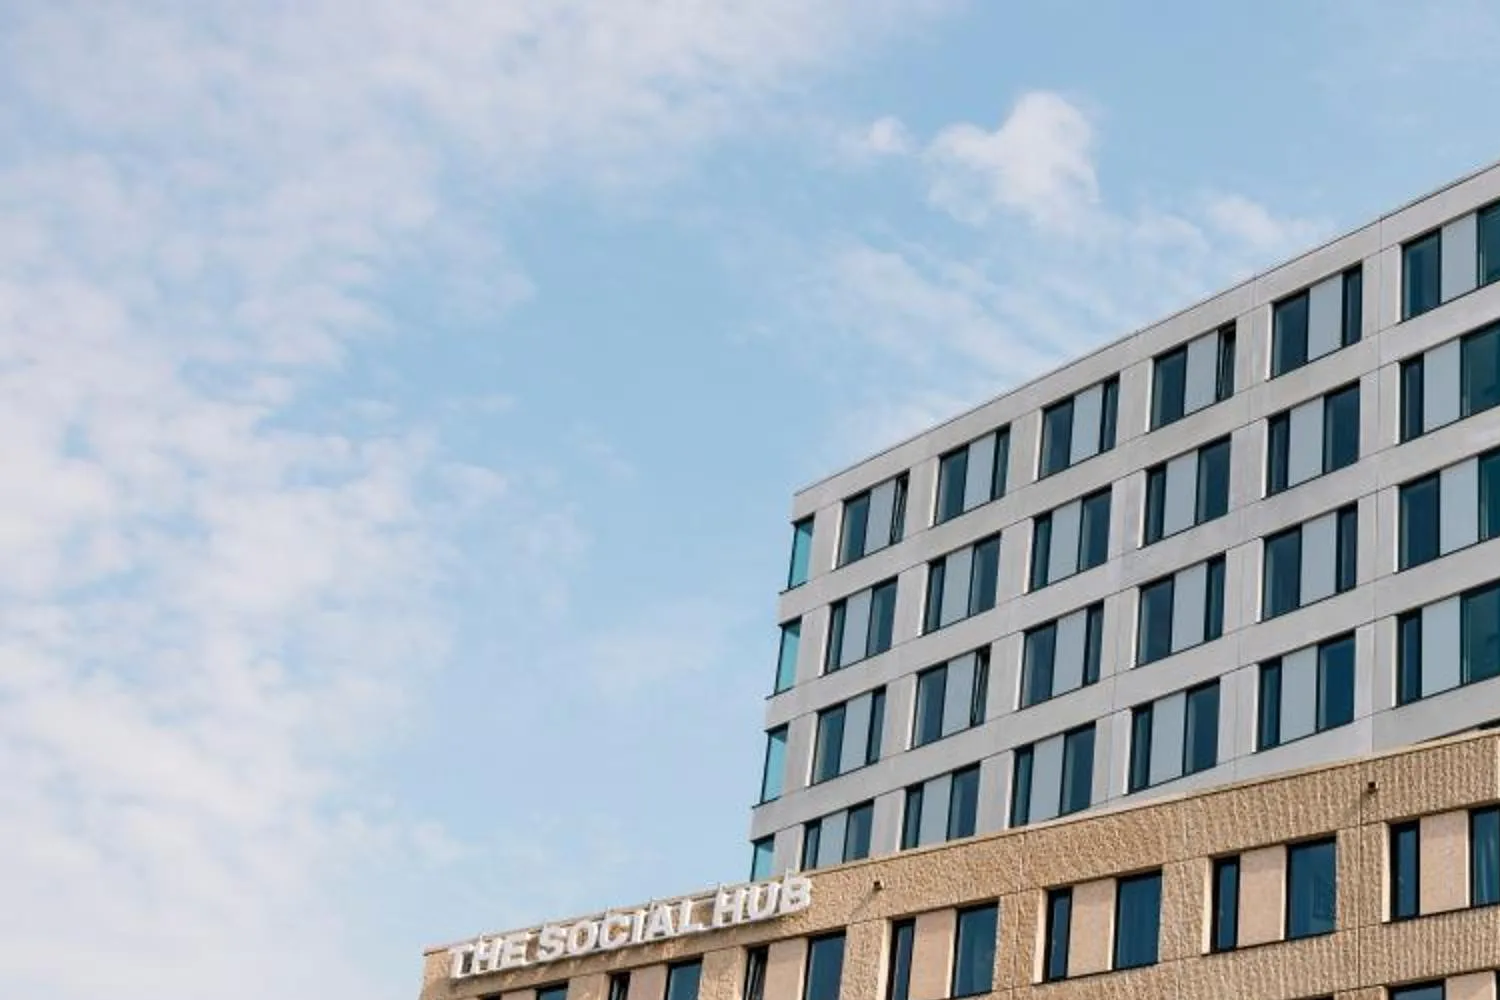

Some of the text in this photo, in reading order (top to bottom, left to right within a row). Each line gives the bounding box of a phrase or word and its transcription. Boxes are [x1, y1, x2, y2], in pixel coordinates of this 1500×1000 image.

[449, 875, 812, 978] THE SOCIAL HUB
